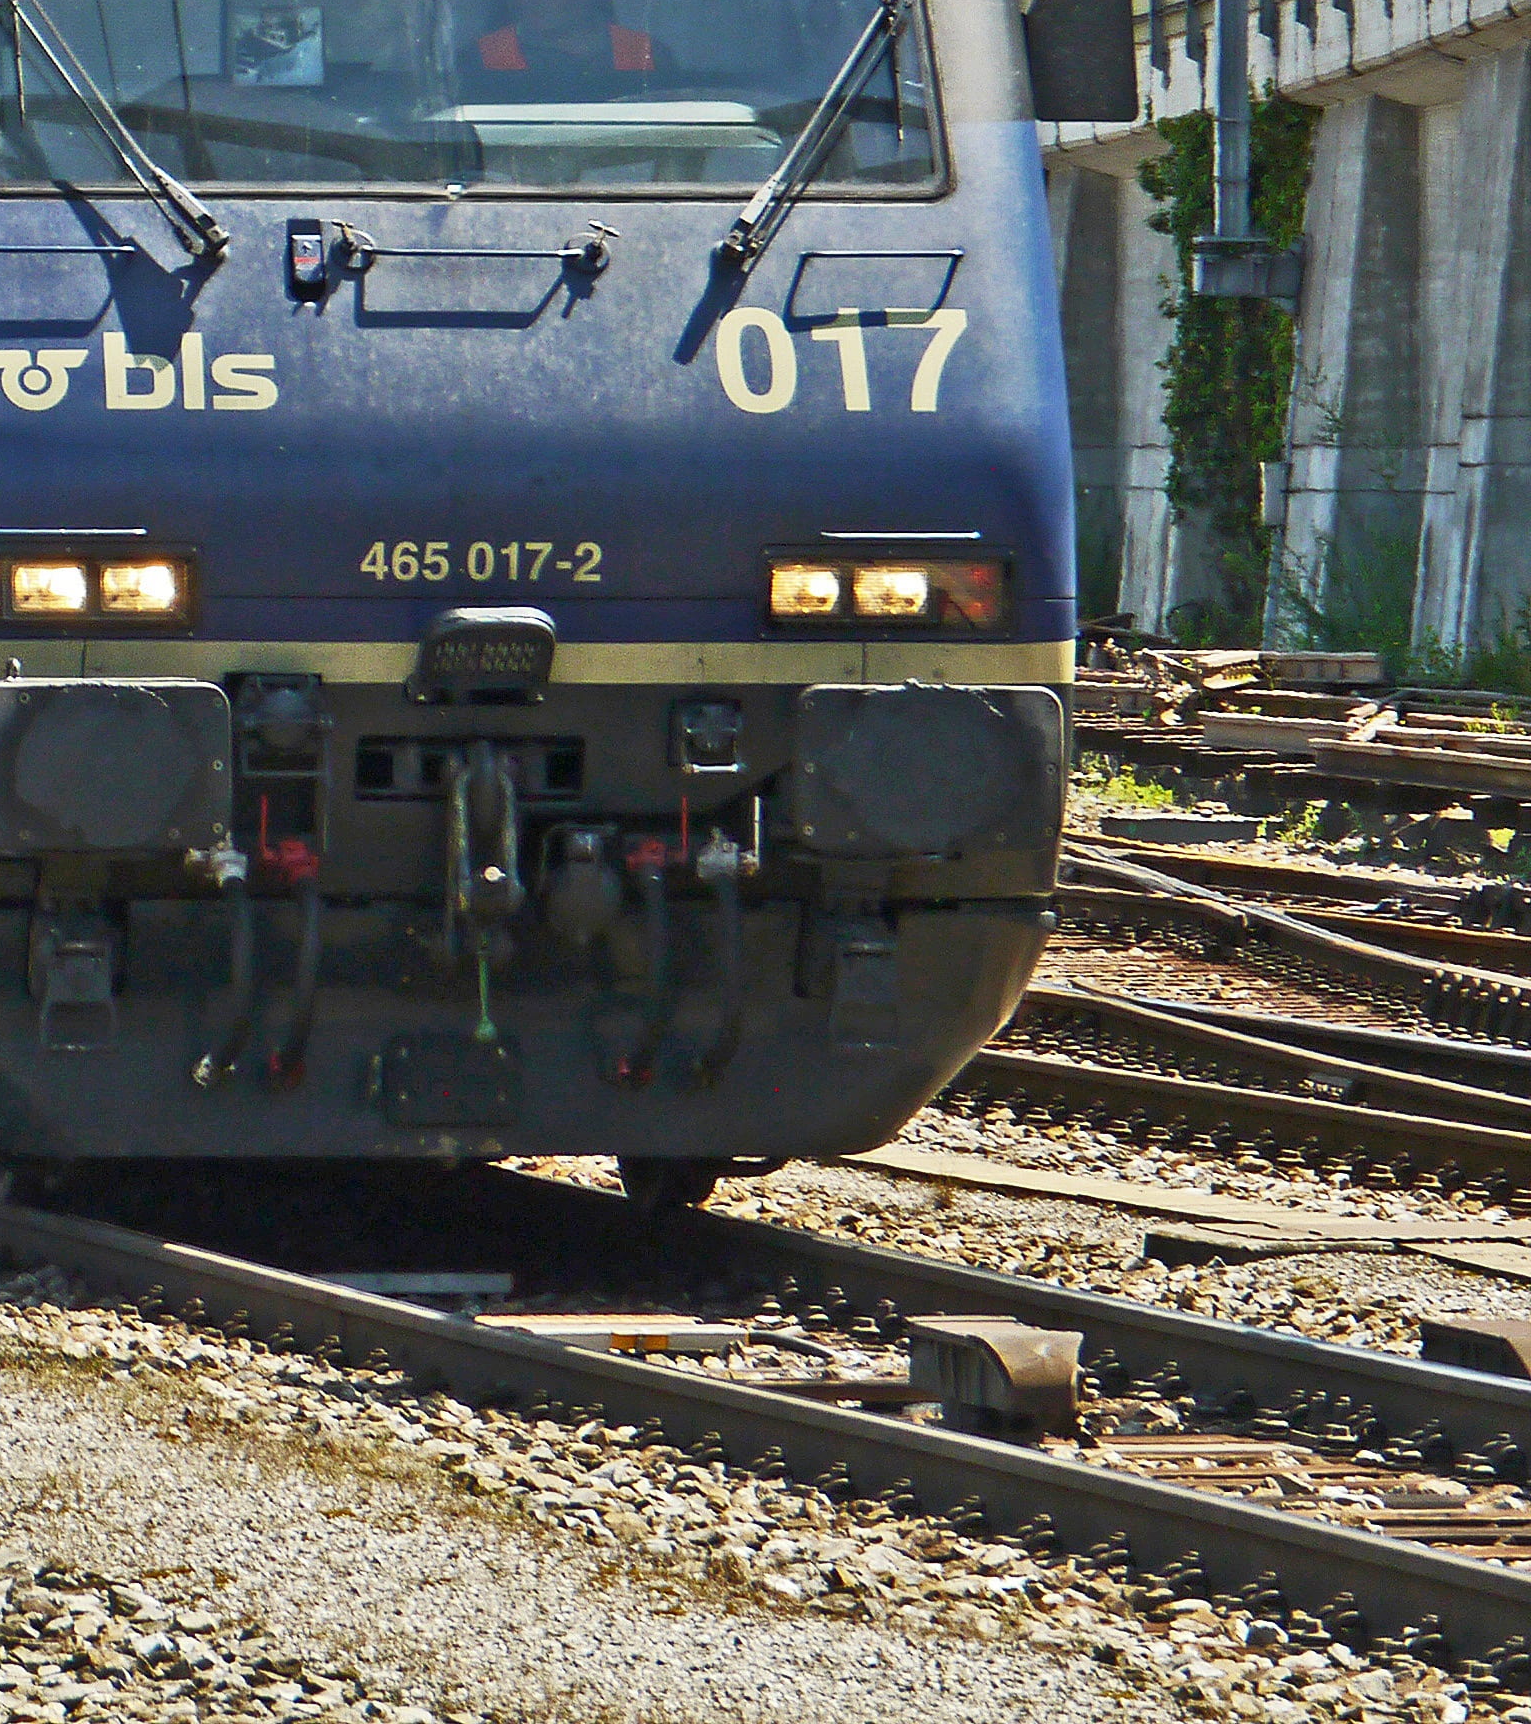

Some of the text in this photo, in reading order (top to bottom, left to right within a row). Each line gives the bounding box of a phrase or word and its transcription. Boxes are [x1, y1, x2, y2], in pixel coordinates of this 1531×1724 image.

[102, 331, 279, 410] bls
[715, 306, 968, 414] 017
[359, 541, 602, 581] 465 017-2
